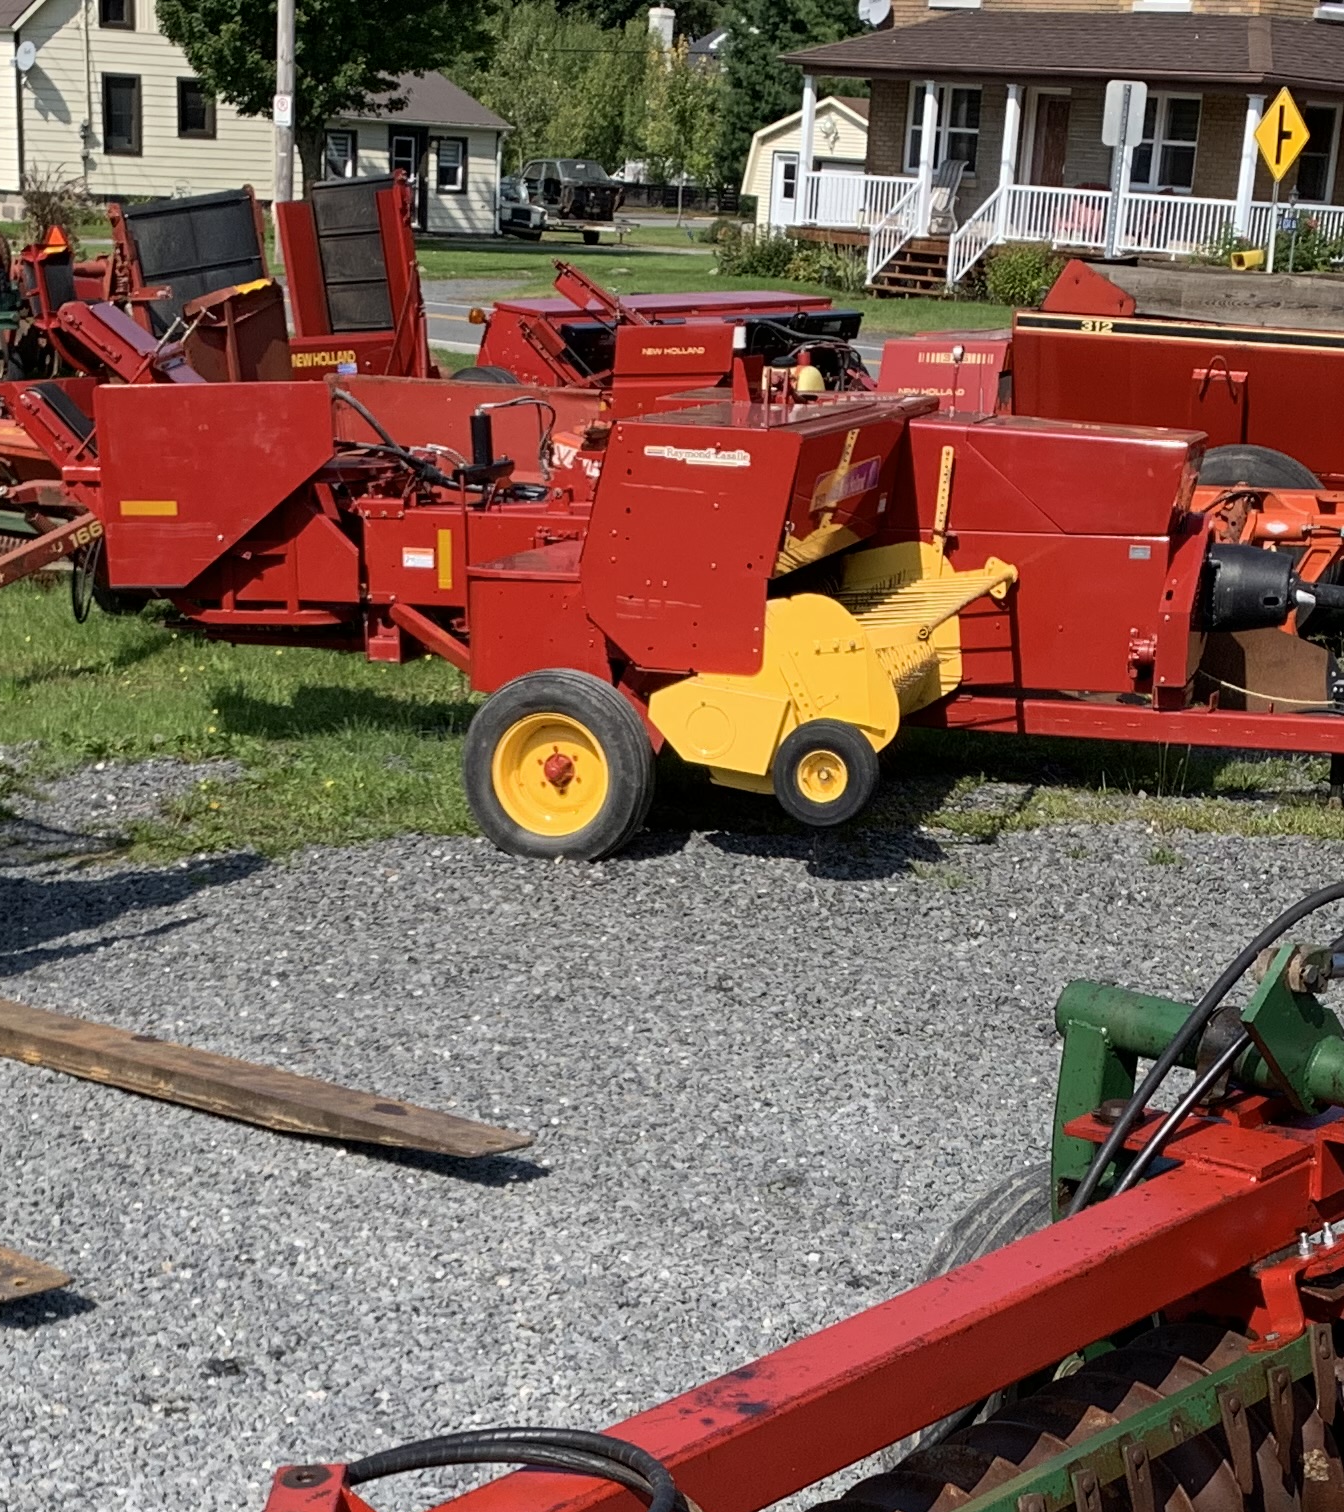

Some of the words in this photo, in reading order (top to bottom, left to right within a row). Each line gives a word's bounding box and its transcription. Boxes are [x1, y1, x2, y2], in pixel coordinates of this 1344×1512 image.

[1081, 320, 1113, 333] 312
[664, 346, 706, 354] HOLLAND
[313, 350, 356, 366] HOLLAND
[920, 387, 965, 396] HOLLAD
[68, 520, 104, 549] 166
